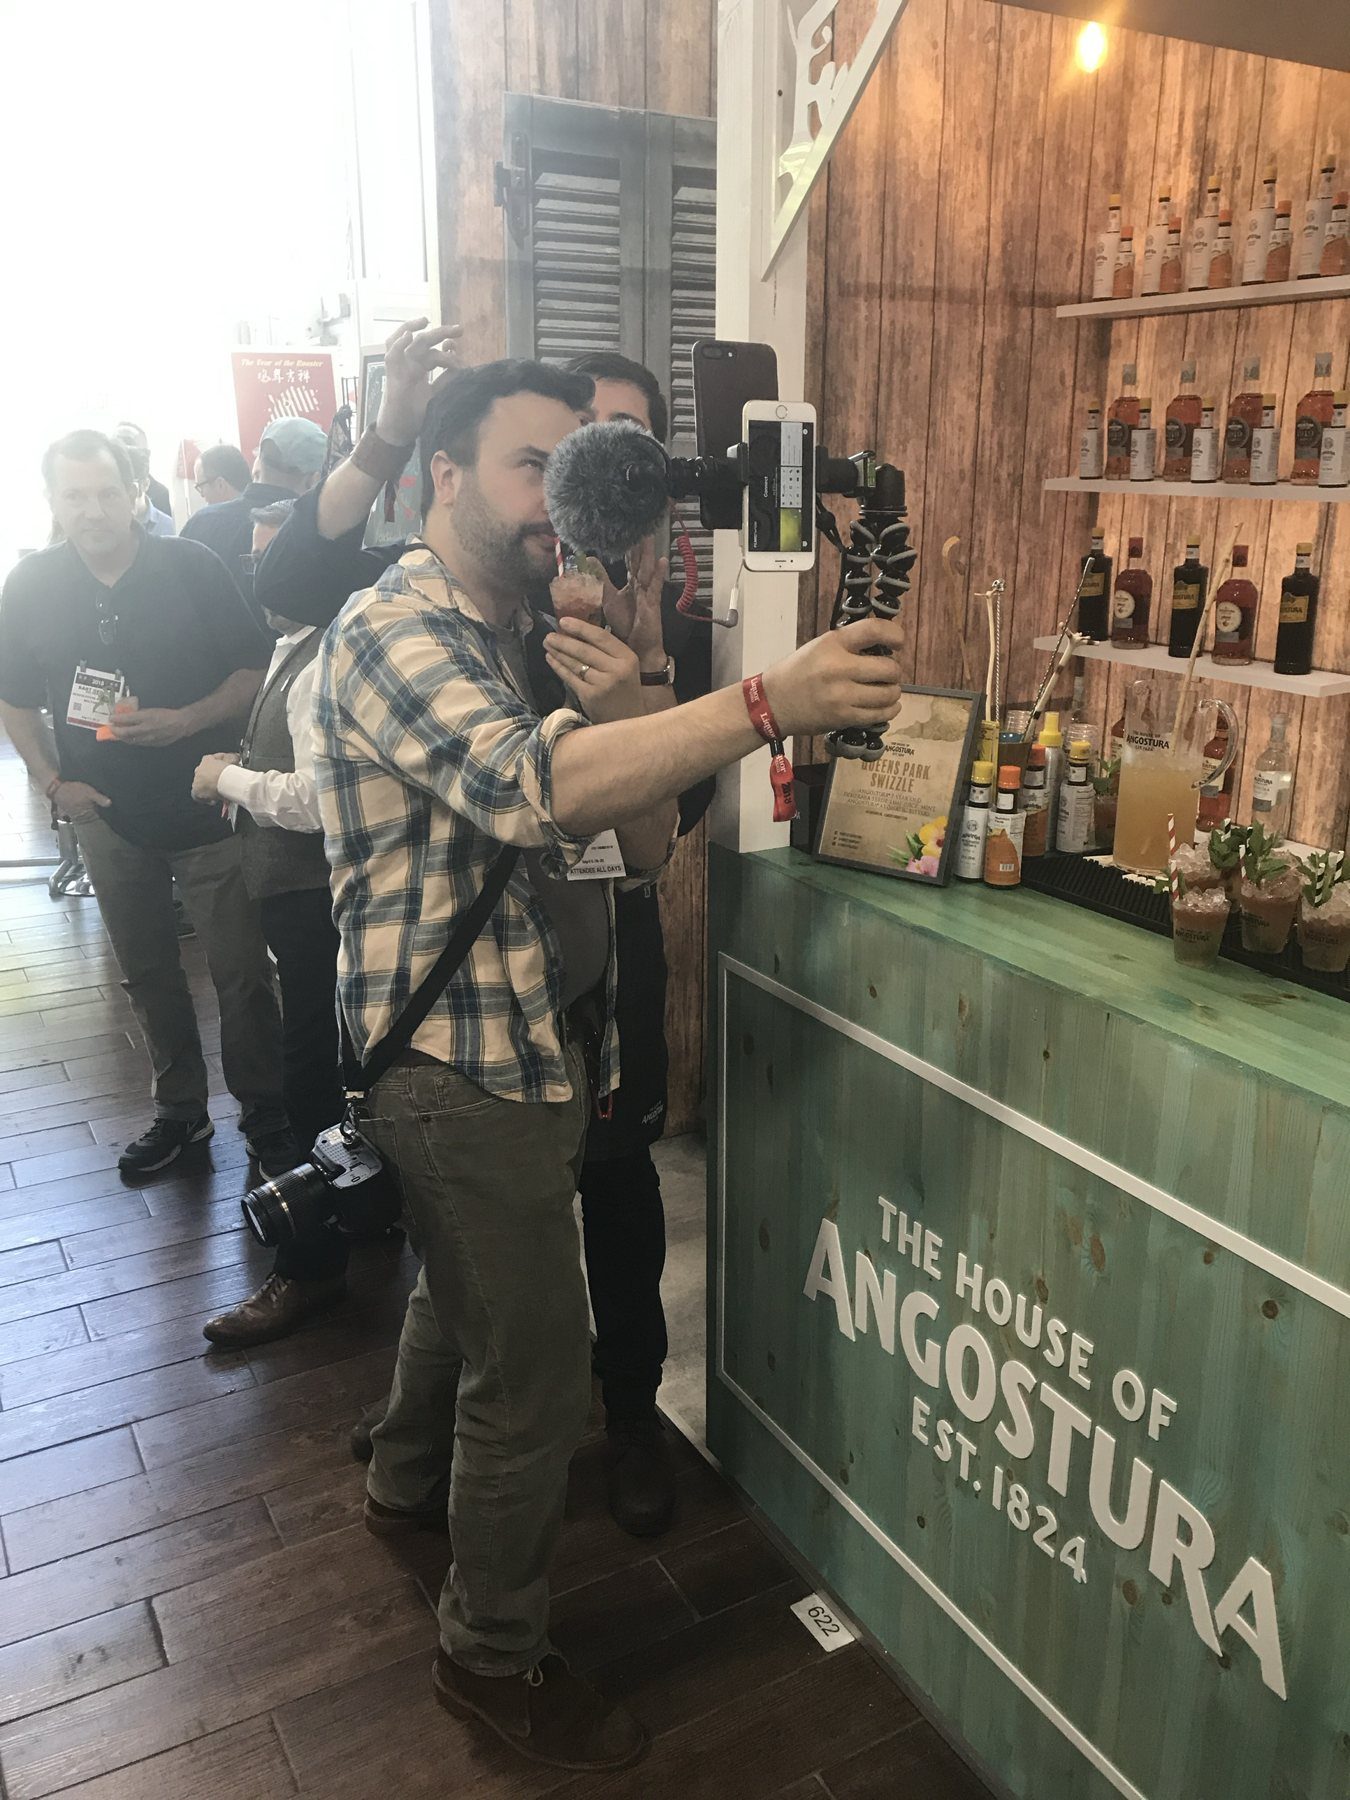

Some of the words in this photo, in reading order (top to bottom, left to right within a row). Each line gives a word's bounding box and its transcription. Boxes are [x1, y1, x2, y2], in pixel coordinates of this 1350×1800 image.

[750, 677, 761, 702] Liquor
[760, 711, 776, 738] Liquor
[1126, 734, 1170, 749] ANGOSTURA
[861, 758, 901, 776] QUEENS
[902, 762, 931, 780] PARK
[870, 772, 915, 793] SWIZZLE
[879, 1196, 943, 1280] THE
[955, 1252, 1095, 1390] HOUSE
[1112, 1369, 1178, 1441] OF
[803, 1217, 1286, 1701] ANGOSTURA
[808, 1606, 840, 1637] 622
